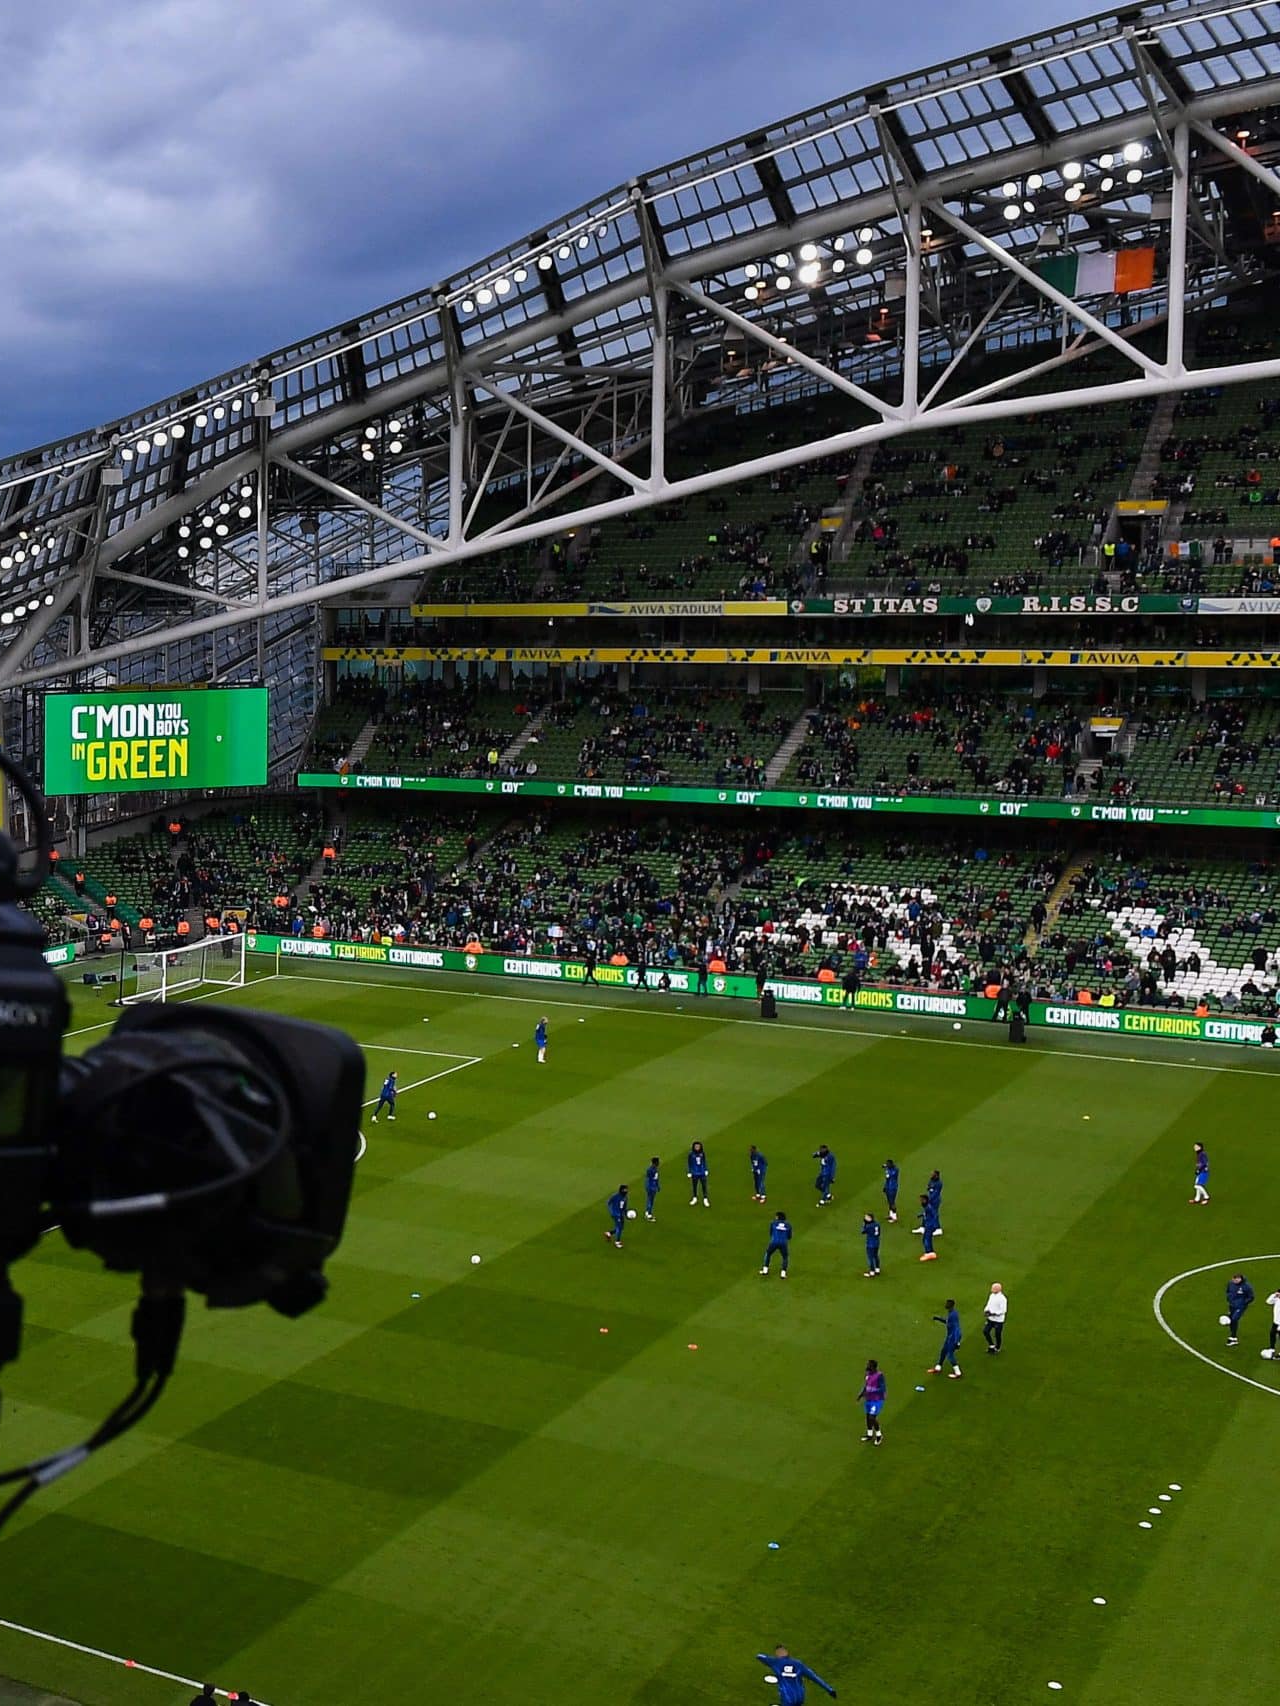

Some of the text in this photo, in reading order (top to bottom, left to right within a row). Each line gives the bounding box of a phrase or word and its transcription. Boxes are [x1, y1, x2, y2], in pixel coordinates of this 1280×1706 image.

[629, 604, 722, 614] AVIVA STADIUM
[834, 598, 938, 614] ST ITA'S
[1022, 596, 1139, 612] R.I.S.S.C
[519, 649, 562, 660] AVIVA
[785, 651, 831, 661] AVIVA
[1086, 653, 1140, 664] AVIVA
[71, 703, 182, 740] C'MON YOU
[155, 719, 189, 737] BOYS
[71, 738, 188, 781] IN GREEN
[356, 775, 382, 787] C'MON
[385, 777, 401, 788] YOU
[573, 785, 601, 796] C'MON
[604, 786, 623, 798] YOU
[817, 795, 847, 808] C'MON
[851, 796, 872, 809] YOU
[1091, 806, 1126, 820] C'MON
[1131, 807, 1154, 821] YOU
[388, 949, 443, 966] CENTURIONS
[503, 958, 562, 977] CENTURIONS
[565, 965, 624, 982] CENRIONS
[763, 982, 967, 1015] NTURIONS CENURIONS CENTURIONS
[1045, 1007, 1280, 1043] CENTURIONS CENTURIONS CENTURIS
